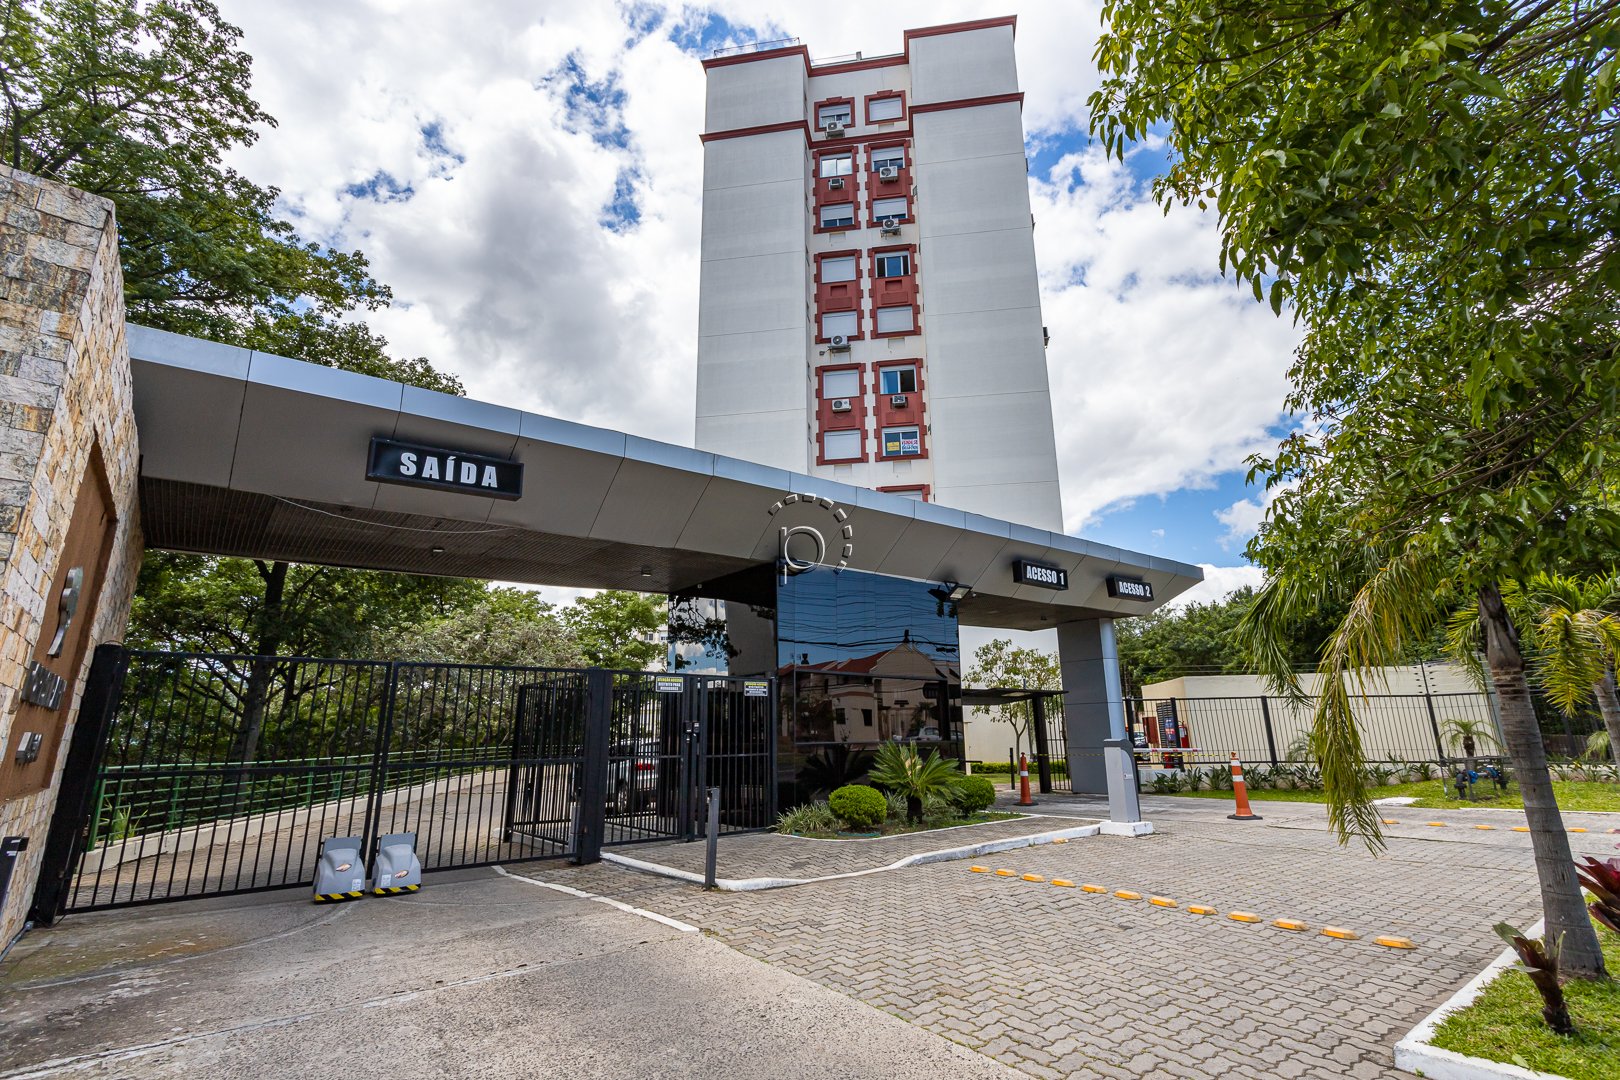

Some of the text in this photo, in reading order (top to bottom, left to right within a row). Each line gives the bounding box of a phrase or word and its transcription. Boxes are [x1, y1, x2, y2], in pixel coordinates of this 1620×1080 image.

[399, 452, 498, 488] SAÍDA
[1026, 565, 1065, 585] ACESSO 1
[1119, 581, 1151, 597] ACESSO 2
